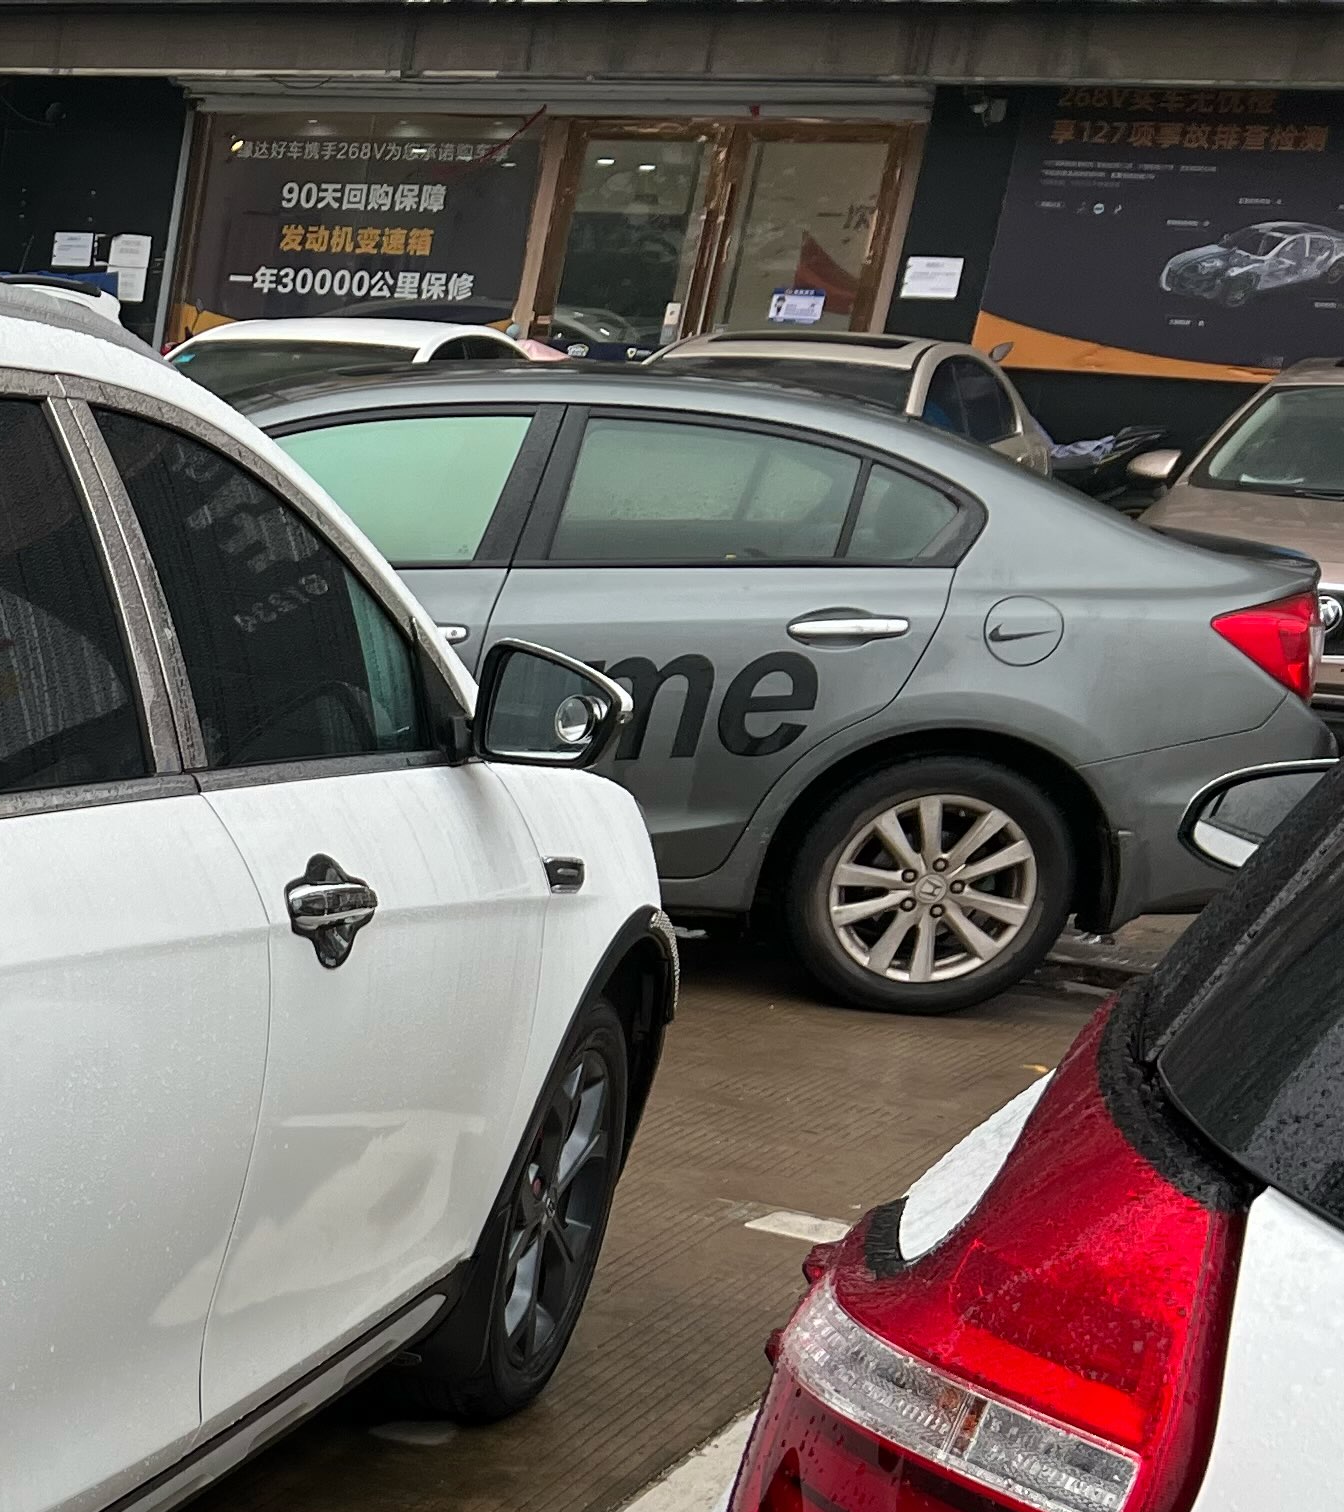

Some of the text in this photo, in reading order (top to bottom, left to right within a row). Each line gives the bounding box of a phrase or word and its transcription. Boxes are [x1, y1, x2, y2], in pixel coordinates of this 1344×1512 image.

[281, 181, 448, 213] 90天回购保障
[279, 224, 435, 256] 发动机变速箱
[229, 266, 474, 301] 一年30000公里保修
